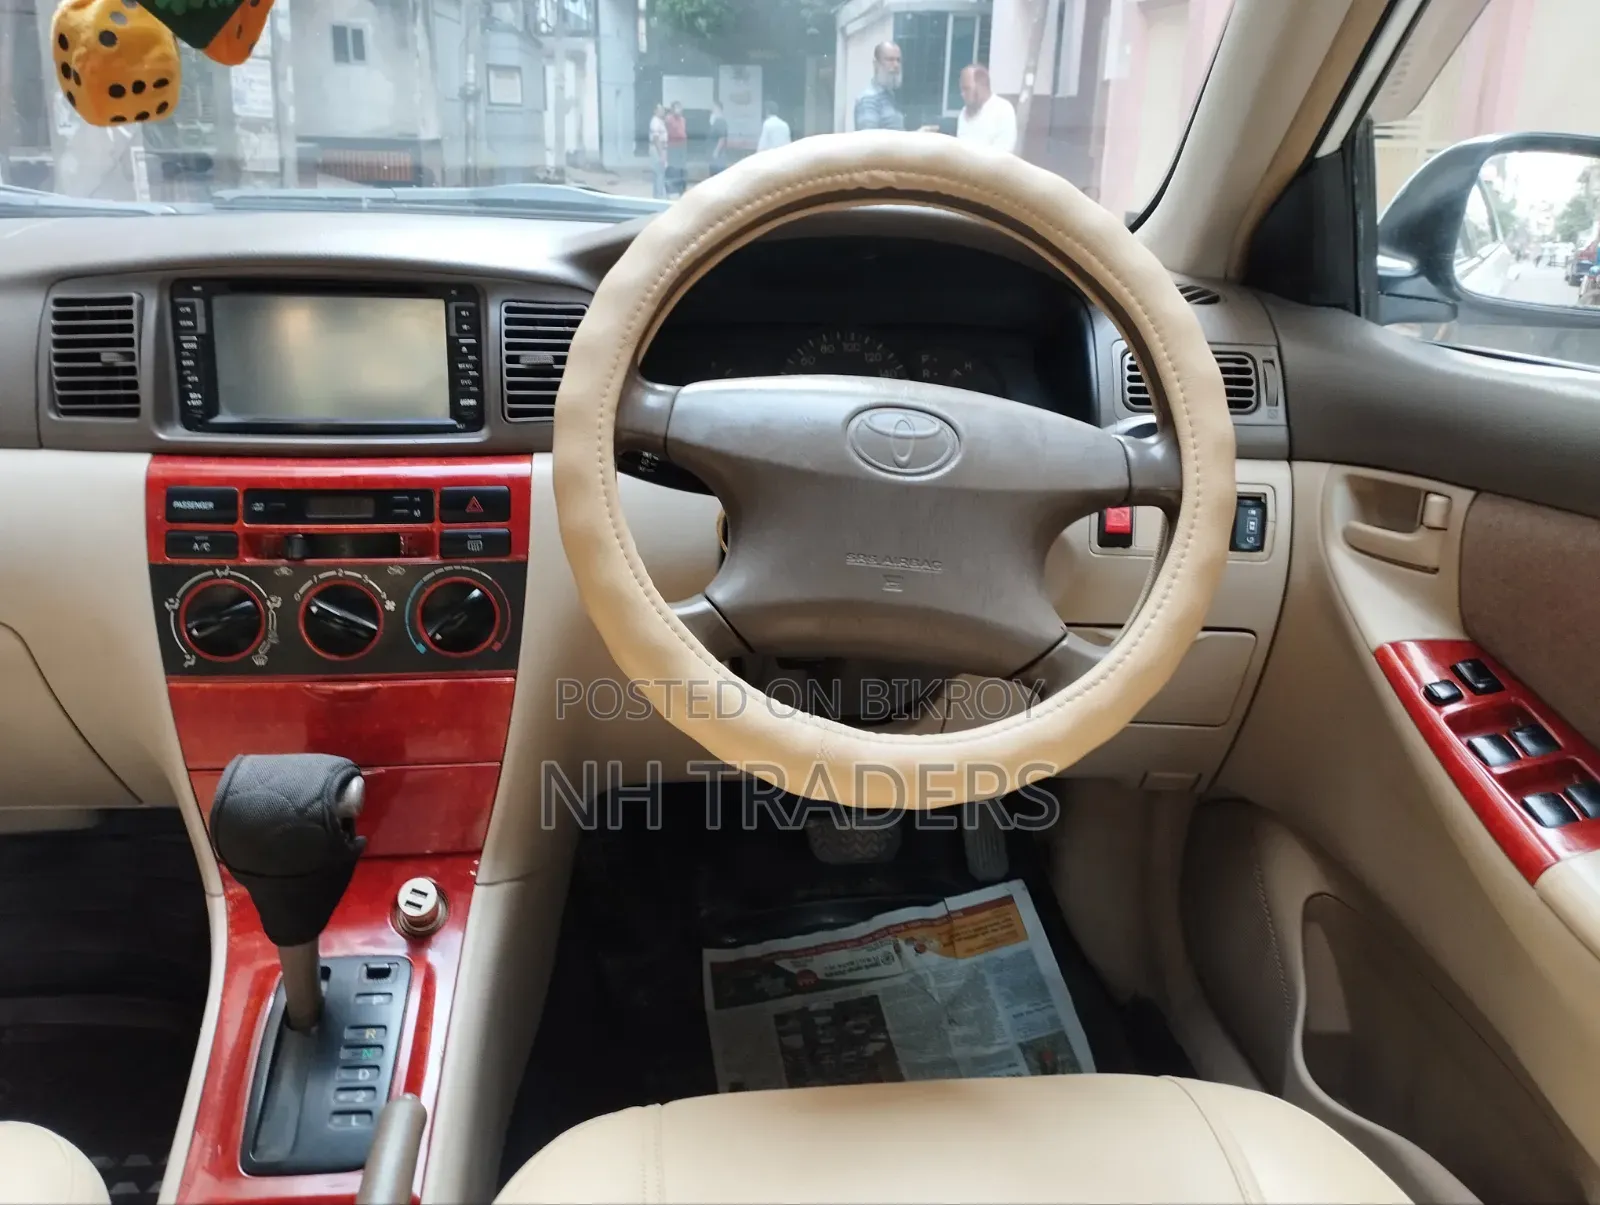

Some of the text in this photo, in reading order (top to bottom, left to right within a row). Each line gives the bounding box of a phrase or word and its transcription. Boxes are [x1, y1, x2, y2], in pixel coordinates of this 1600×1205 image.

[842, 342, 862, 352] 100
[800, 355, 816, 366] 60
[864, 352, 883, 362] 120
[172, 501, 215, 510] PASSENGER
[192, 542, 211, 552] A/C
[365, 1028, 376, 1039] R
[361, 1049, 373, 1059] N
[358, 1069, 370, 1080] D
